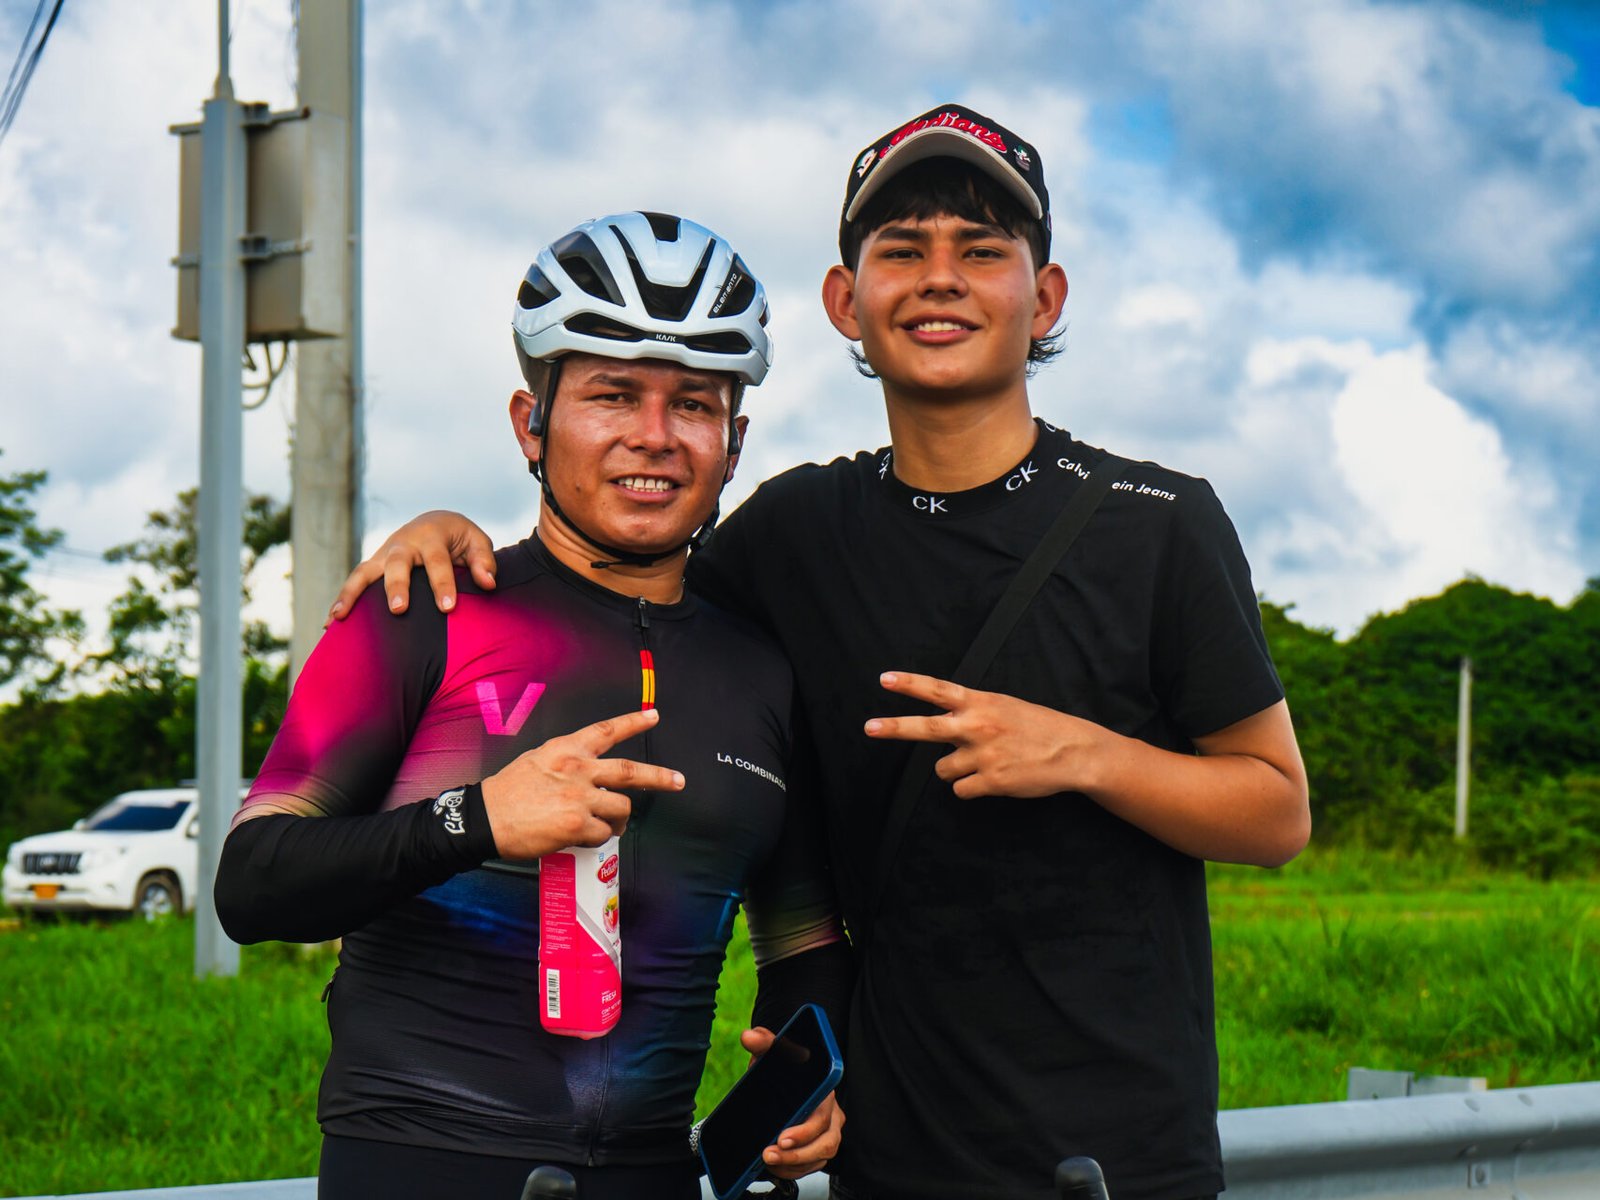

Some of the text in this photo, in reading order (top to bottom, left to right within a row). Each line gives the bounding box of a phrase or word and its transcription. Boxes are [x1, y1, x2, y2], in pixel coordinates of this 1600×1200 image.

[655, 332, 676, 343] KASK
[1004, 460, 1039, 492] CK
[1056, 457, 1177, 501] Calvi ein Jeans
[912, 494, 949, 514] CK
[716, 752, 733, 765] LA
